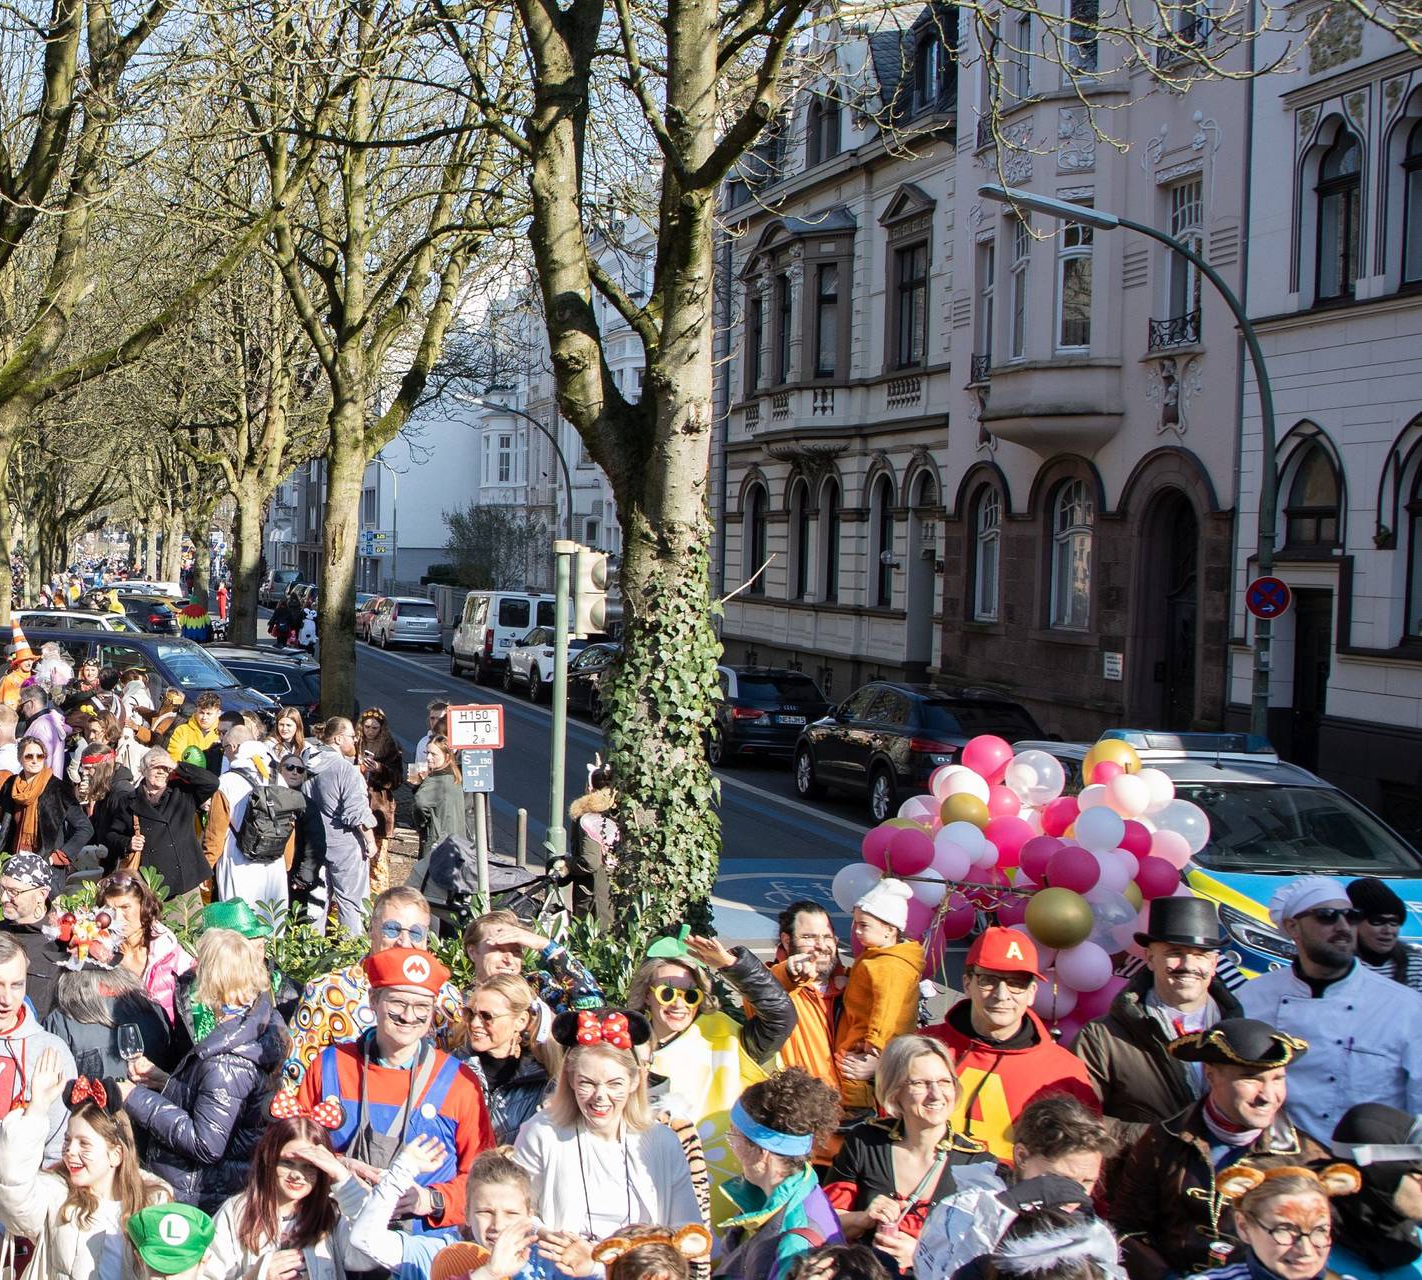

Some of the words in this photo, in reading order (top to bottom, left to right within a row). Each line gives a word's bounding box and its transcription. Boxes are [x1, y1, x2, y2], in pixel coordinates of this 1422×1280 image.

[460, 711, 489, 720] H150
[463, 755, 471, 765] S
[1006, 941, 1024, 960] A
[406, 961, 426, 976] M
[948, 1066, 1016, 1162] A
[166, 1220, 182, 1239] L
